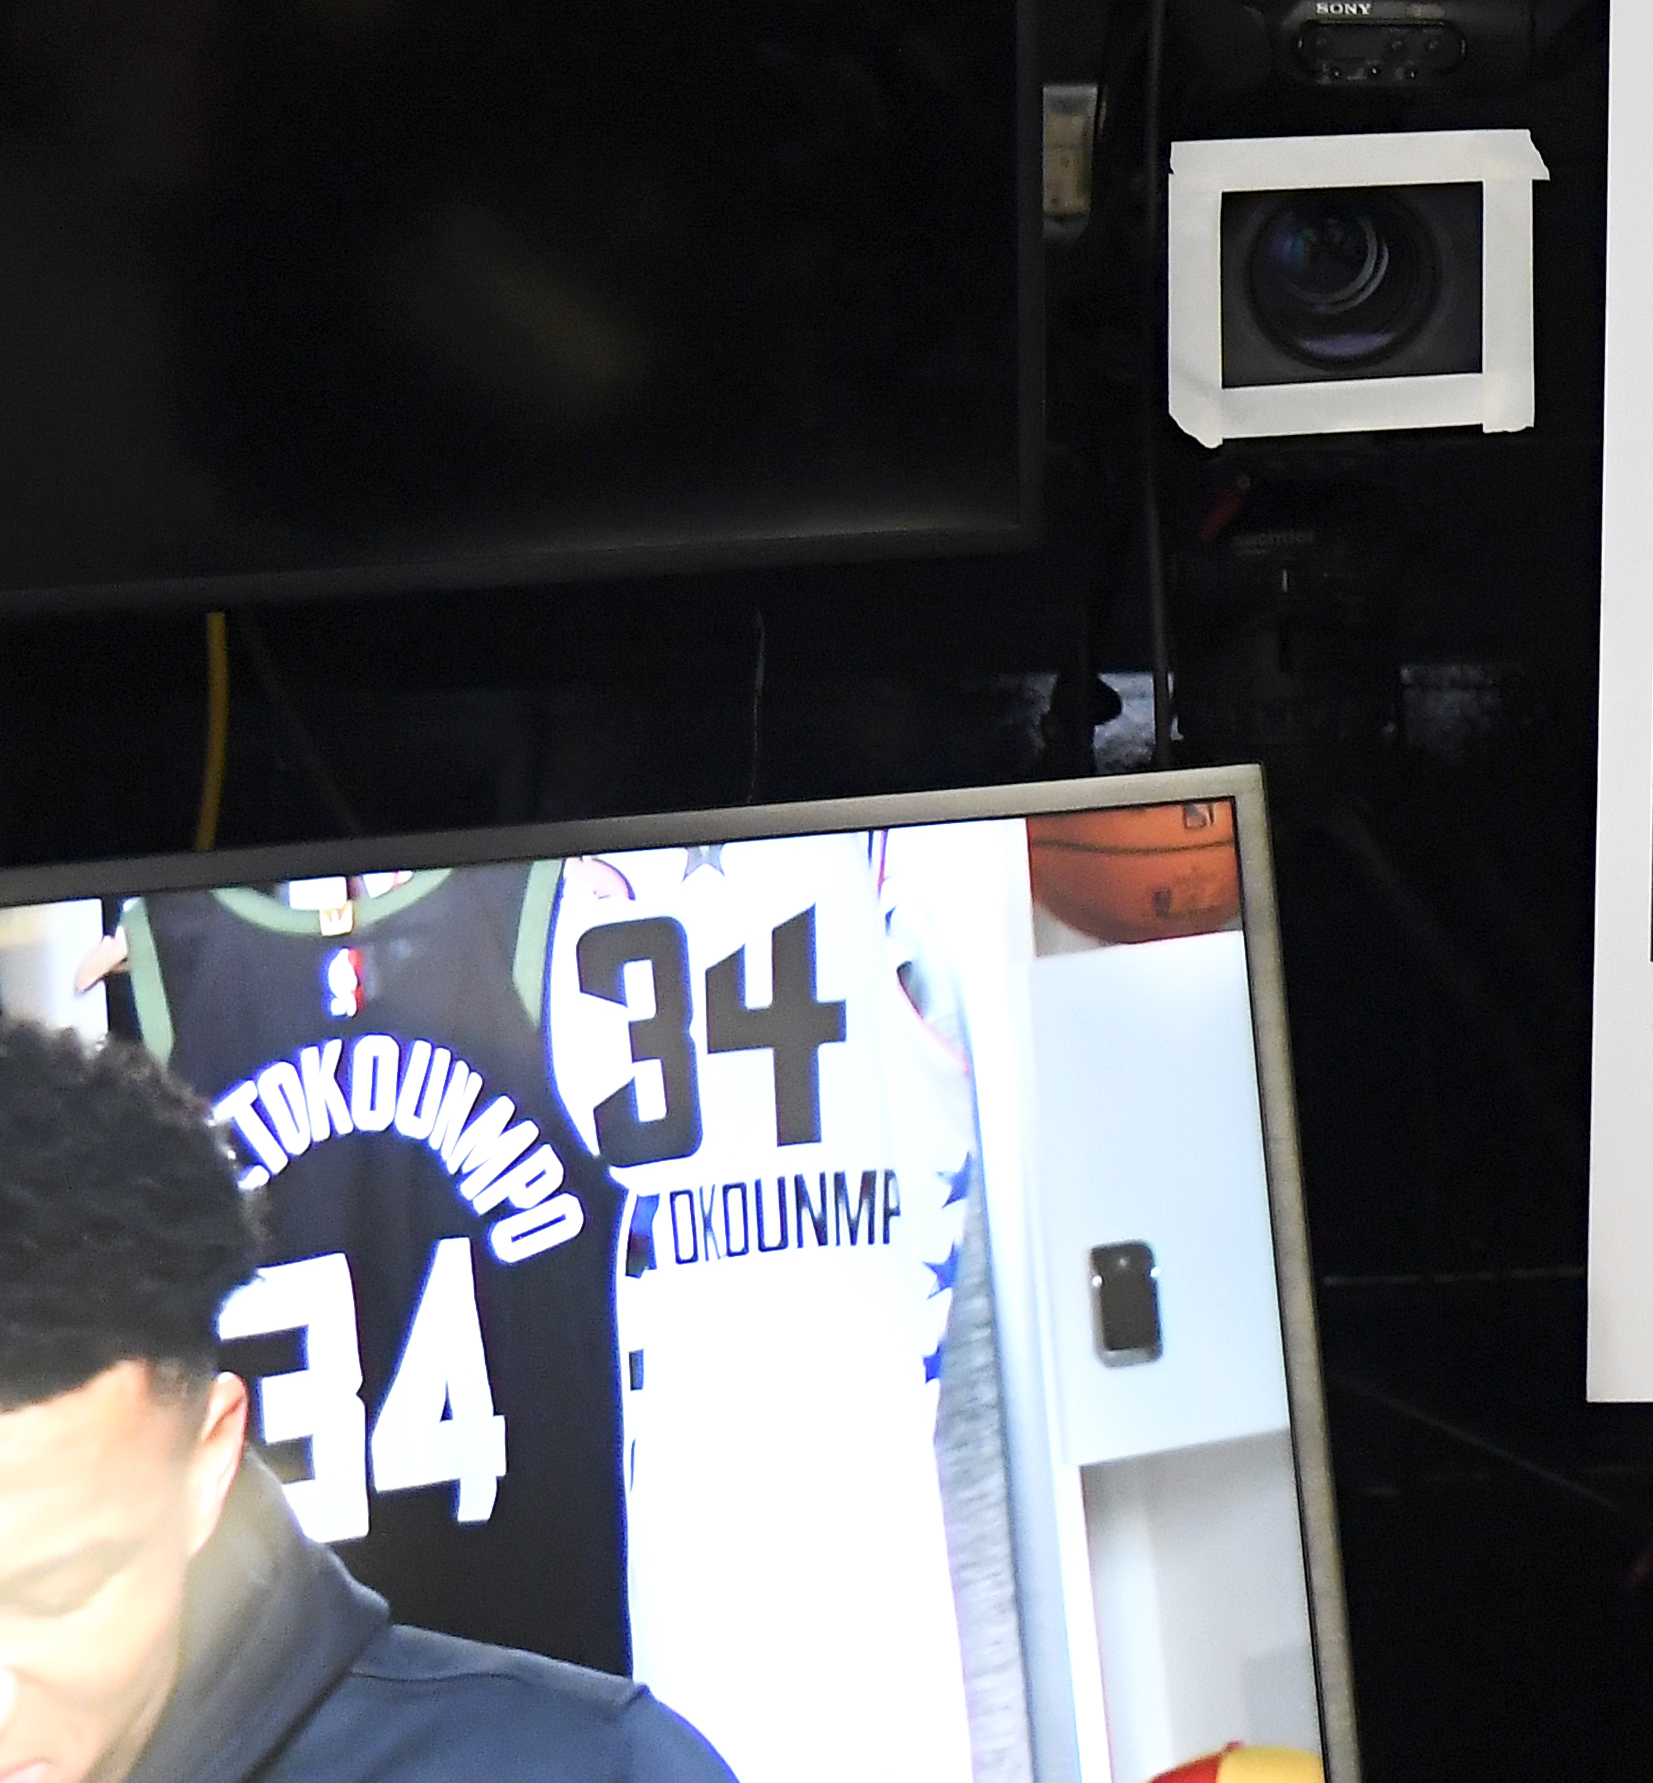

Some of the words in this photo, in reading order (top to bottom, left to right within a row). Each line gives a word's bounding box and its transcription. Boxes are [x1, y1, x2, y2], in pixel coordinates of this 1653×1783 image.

[1316, 2, 1371, 15] SONY
[576, 902, 847, 1168] 34
[217, 1236, 508, 1545] 34
